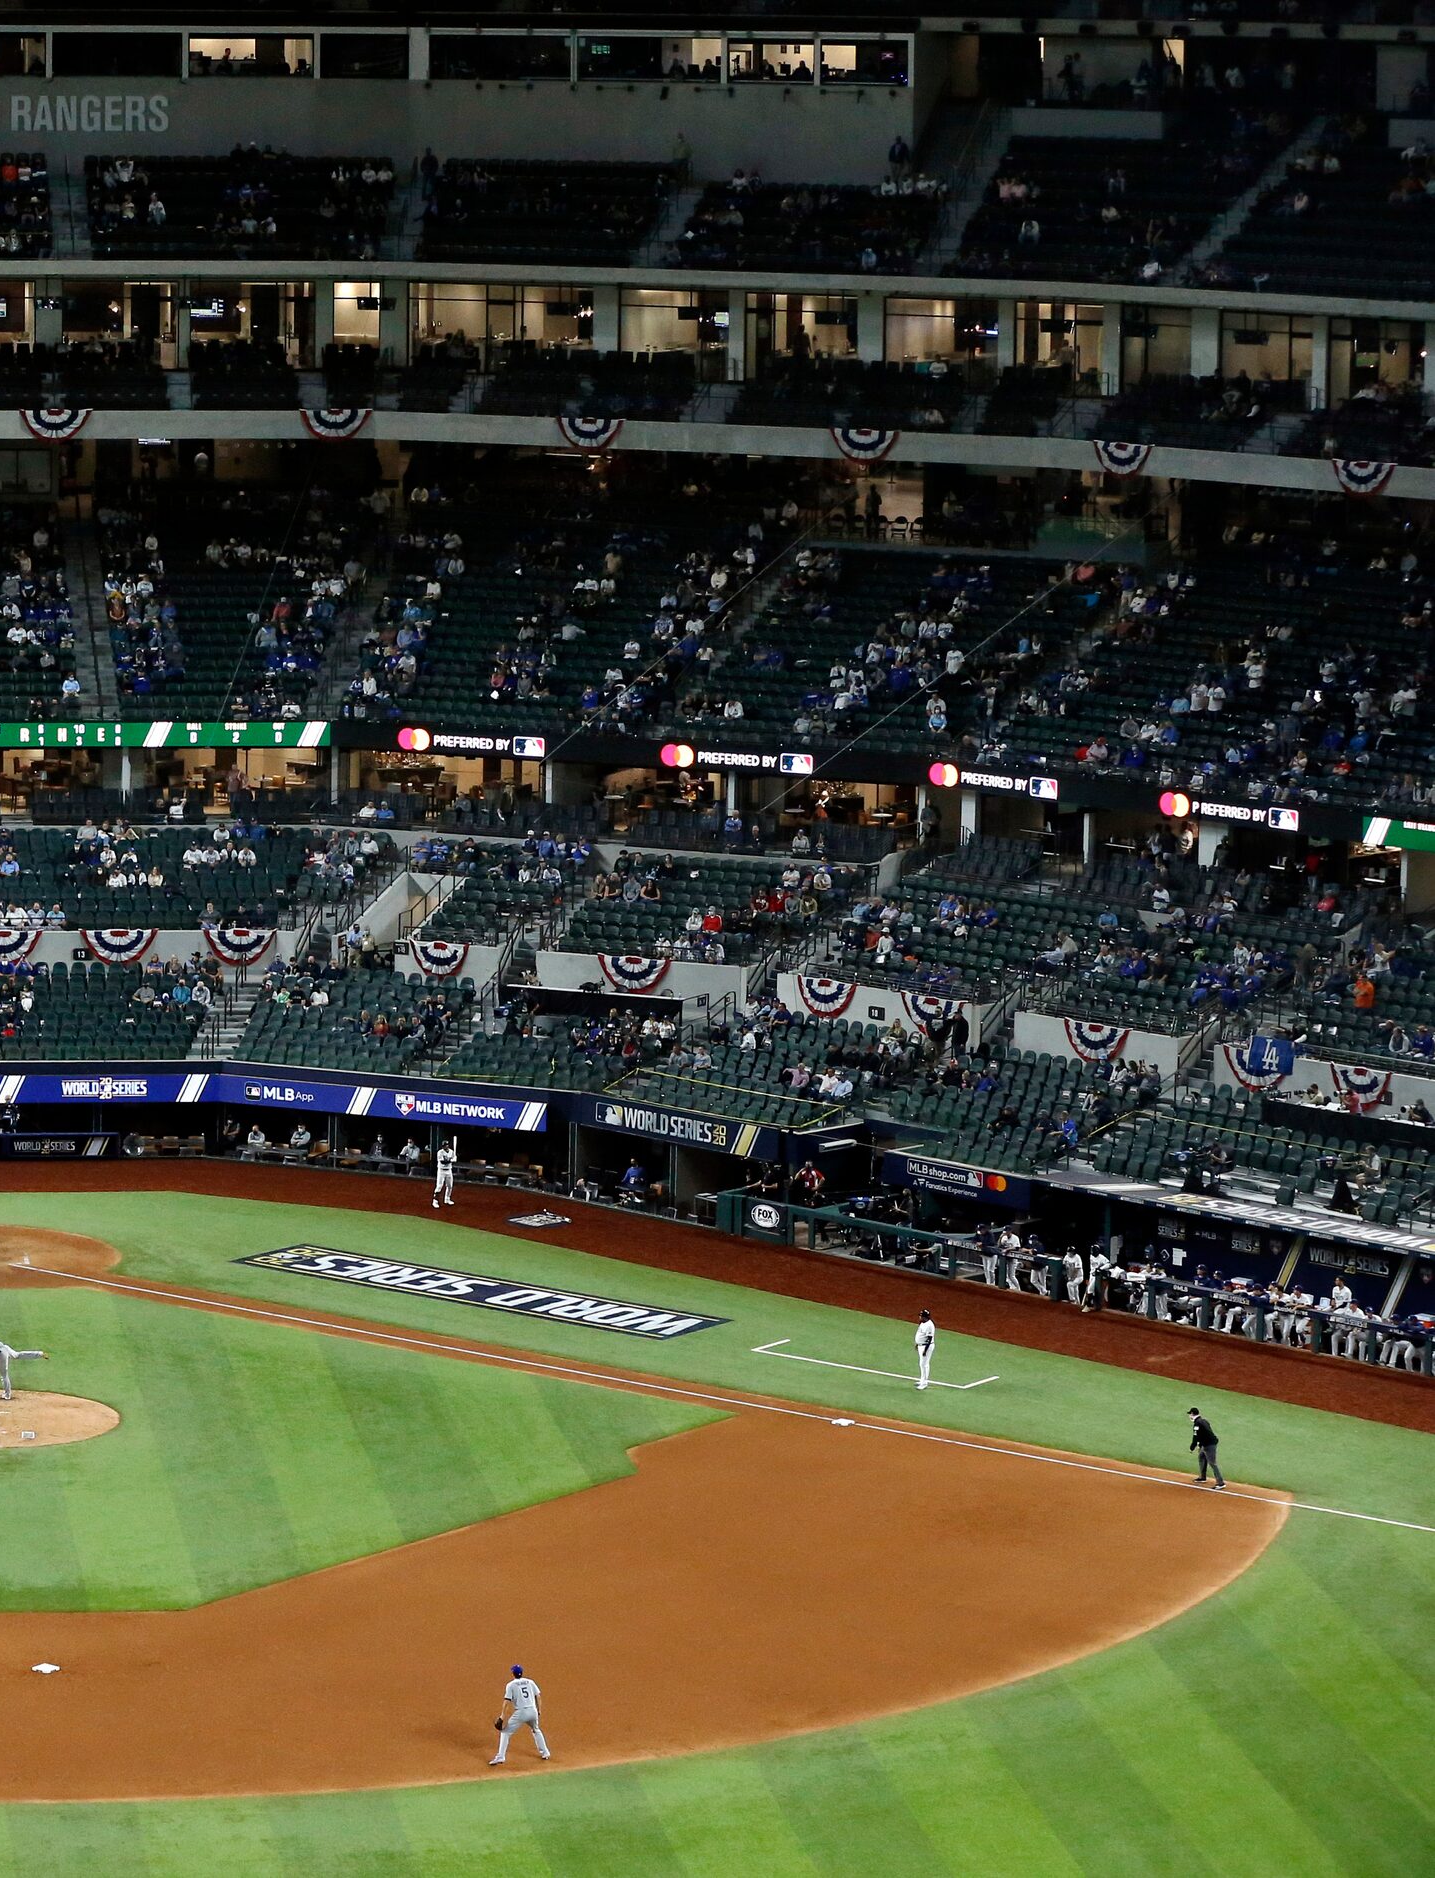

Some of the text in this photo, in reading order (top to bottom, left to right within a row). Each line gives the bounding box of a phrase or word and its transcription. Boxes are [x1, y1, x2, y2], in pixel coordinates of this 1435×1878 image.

[9, 95, 168, 133] RANGERS
[73, 724, 85, 733] 10
[224, 722, 247, 731] STRIKE
[20, 728, 29, 743] R
[57, 728, 67, 742] H
[97, 728, 105, 742] E
[38, 737, 44, 746] 1
[189, 732, 282, 743] 0 2 0
[433, 735, 510, 750] PREFERRED BY
[697, 751, 777, 768] PREFERRED BY
[961, 772, 1028, 791] PREFERRED BY
[1192, 801, 1266, 822] PREFERRED BY
[1262, 1039, 1279, 1071] LA
[61, 1081, 147, 1095] WORLD SERIES
[263, 1086, 314, 1102] MLB App
[416, 1101, 505, 1119] MLB NETWORK
[624, 1107, 713, 1143] WORLD SERIES
[713, 1124, 726, 1135] 20
[14, 1141, 75, 1151] WORLD SERIES
[713, 1134, 726, 1146] 20
[925, 1180, 948, 1192] Fanatics
[948, 1185, 977, 1198] Experience
[757, 1208, 773, 1220] FOX
[1192, 1200, 1318, 1224] SERIES
[1302, 1220, 1431, 1248] WORLD
[1309, 1247, 1343, 1267] WORLD
[1356, 1256, 1389, 1275] SERIES
[290, 1255, 703, 1335] WORLD SERIES
[521, 1687, 529, 1698] 5
